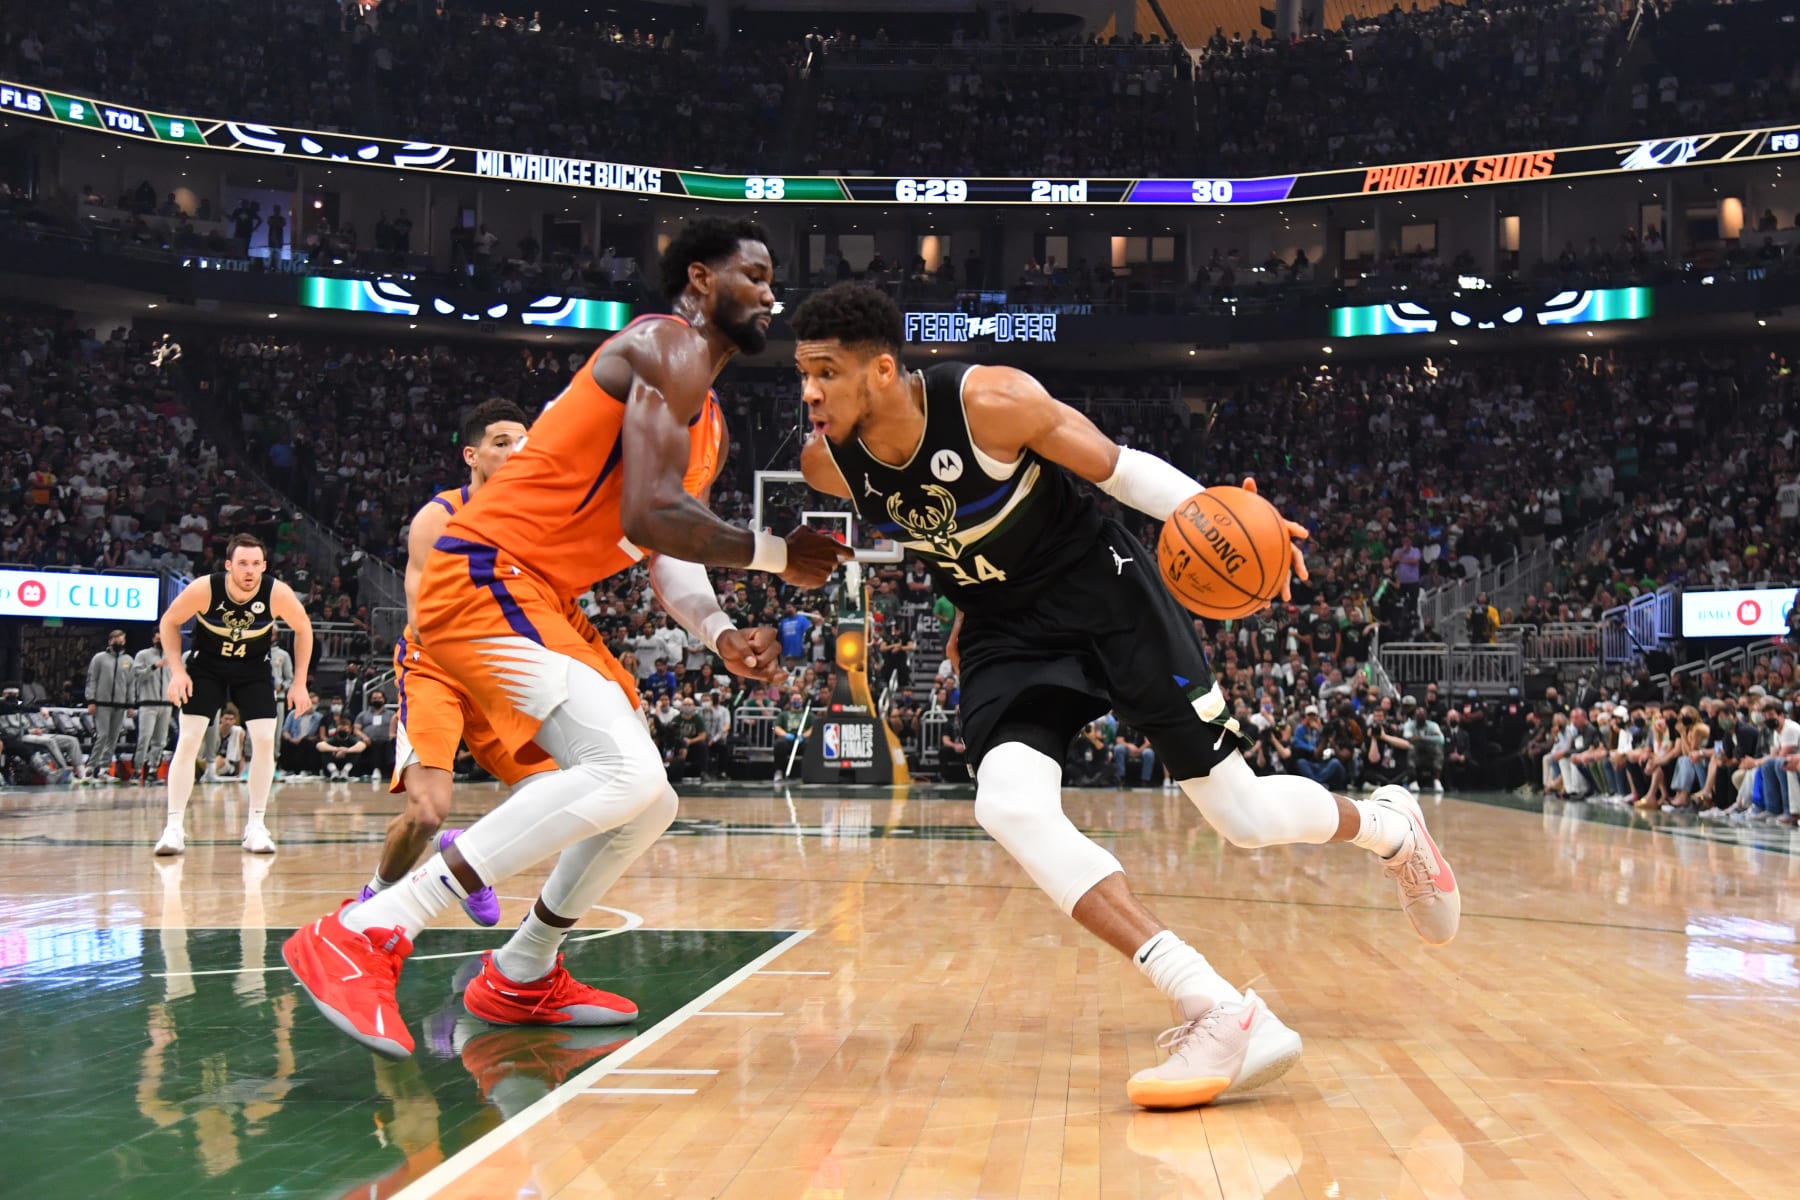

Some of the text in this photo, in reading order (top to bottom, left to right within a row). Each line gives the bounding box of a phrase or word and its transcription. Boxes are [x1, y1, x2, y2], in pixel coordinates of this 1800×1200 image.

[0, 88, 185, 138] FLS 2 TOL 5
[476, 150, 661, 193] MILWAUKEE BUCKS
[1362, 152, 1556, 193] PHOENIX SUNS
[745, 177, 785, 200] 33
[896, 179, 967, 202] 6:29
[1031, 178, 1087, 202] 2nd
[1192, 180, 1233, 203] 30
[905, 312, 1057, 342] FEAR THE DEER
[1179, 500, 1247, 574] SPALDING
[68, 585, 141, 608] CLUB
[221, 641, 247, 658] 24
[841, 724, 861, 741] NBA
[841, 741, 874, 758] FINALS
